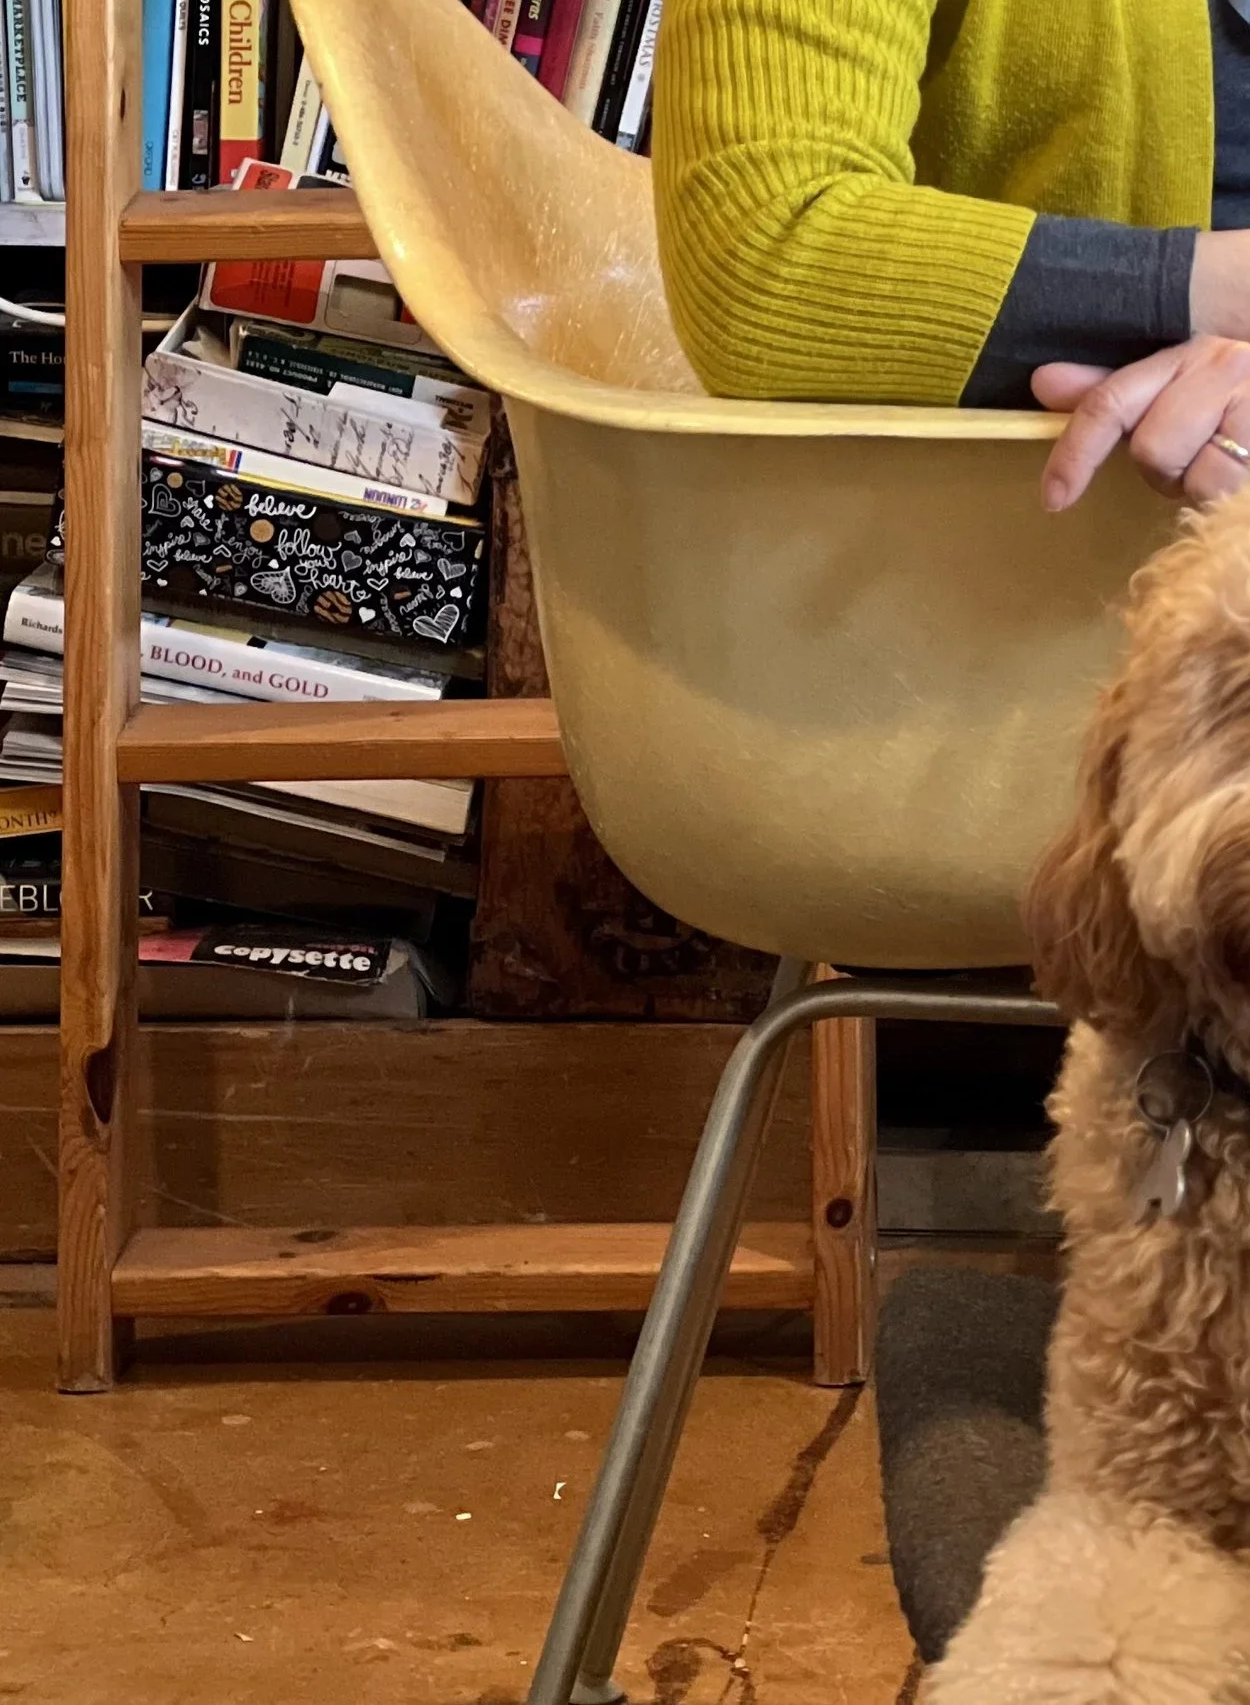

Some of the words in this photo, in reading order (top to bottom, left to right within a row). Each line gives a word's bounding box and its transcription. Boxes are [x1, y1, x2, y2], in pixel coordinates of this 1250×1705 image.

[8, 350, 37, 365] The
[244, 493, 317, 520] believe
[143, 530, 192, 558] inspire
[226, 536, 270, 569] enjoy
[275, 528, 343, 562] follow
[362, 548, 412, 577] inspire
[150, 644, 227, 678] BLOOD,
[231, 668, 264, 685] and
[268, 673, 330, 700] GOLD
[212, 943, 372, 974] copysette
